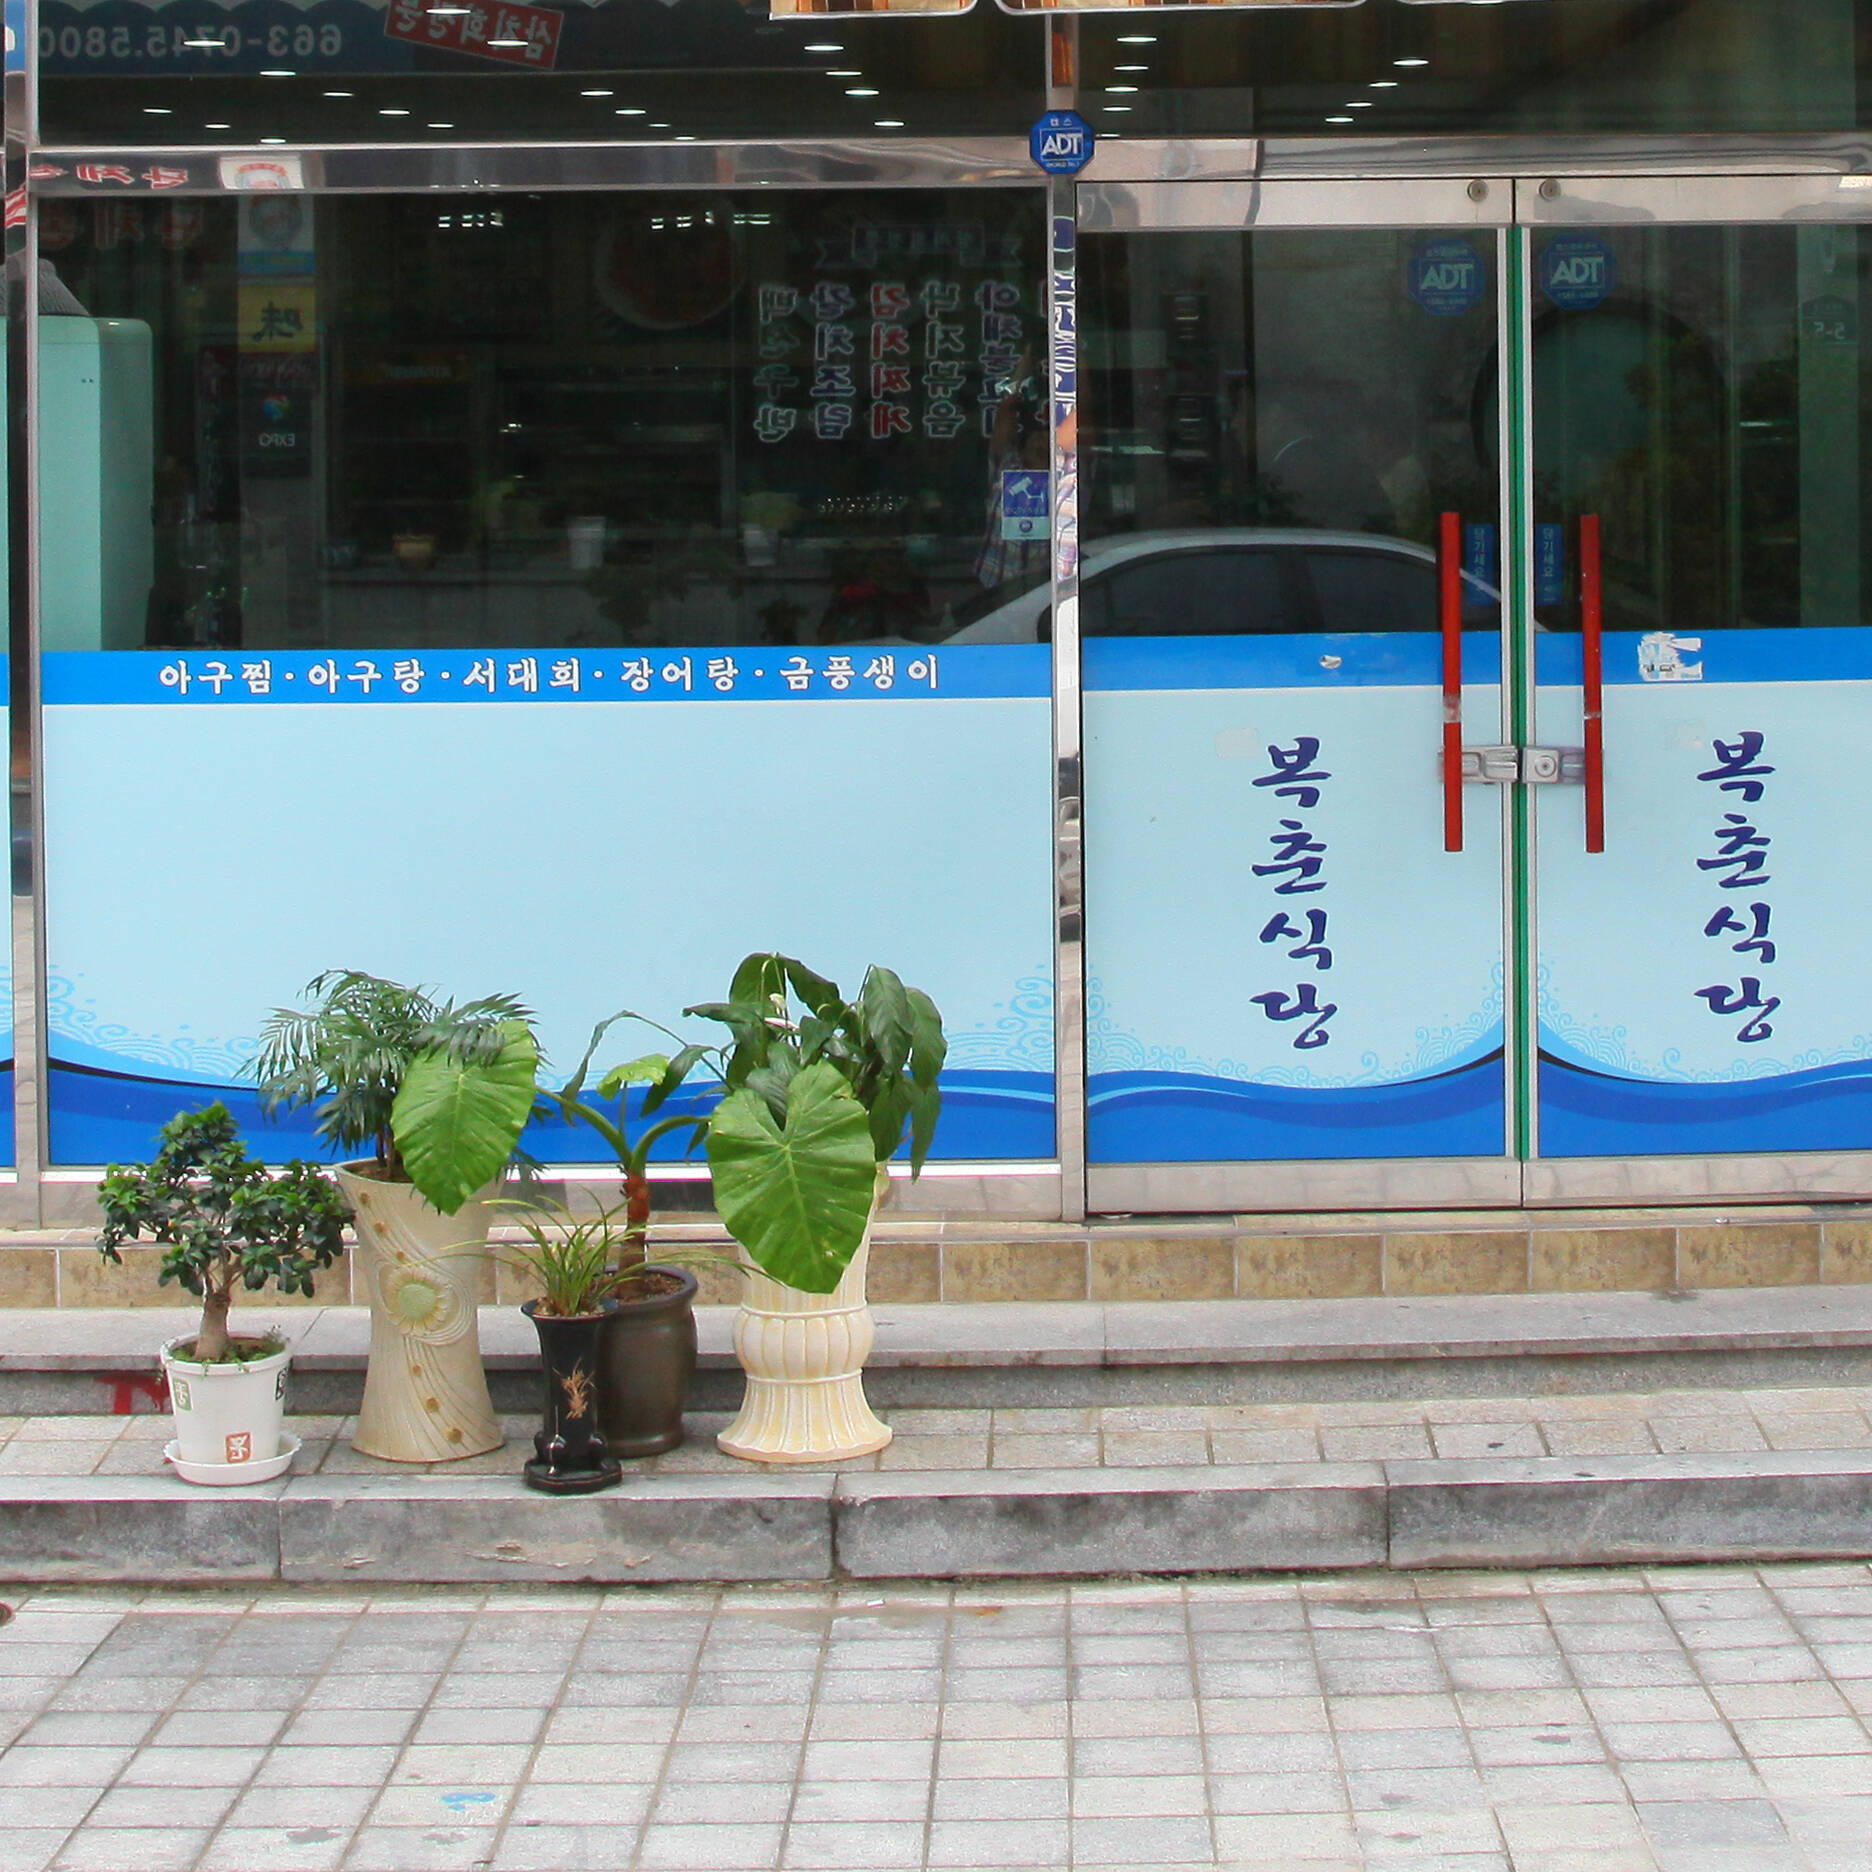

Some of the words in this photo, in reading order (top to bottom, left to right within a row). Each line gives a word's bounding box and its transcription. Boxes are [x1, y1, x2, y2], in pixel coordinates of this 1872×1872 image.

[1041, 132, 1083, 156] ADT
[1420, 262, 1475, 291] ADT
[1549, 255, 1604, 285] ADT
[159, 659, 271, 695] 아구찜
[308, 658, 425, 694] 아구탕
[463, 657, 579, 693] 서대회
[620, 656, 739, 692] 장어탕
[779, 654, 937, 690] 금풍생이
[1249, 735, 1338, 1049] 복춘식당
[1694, 730, 1781, 1043] 복춘식당
